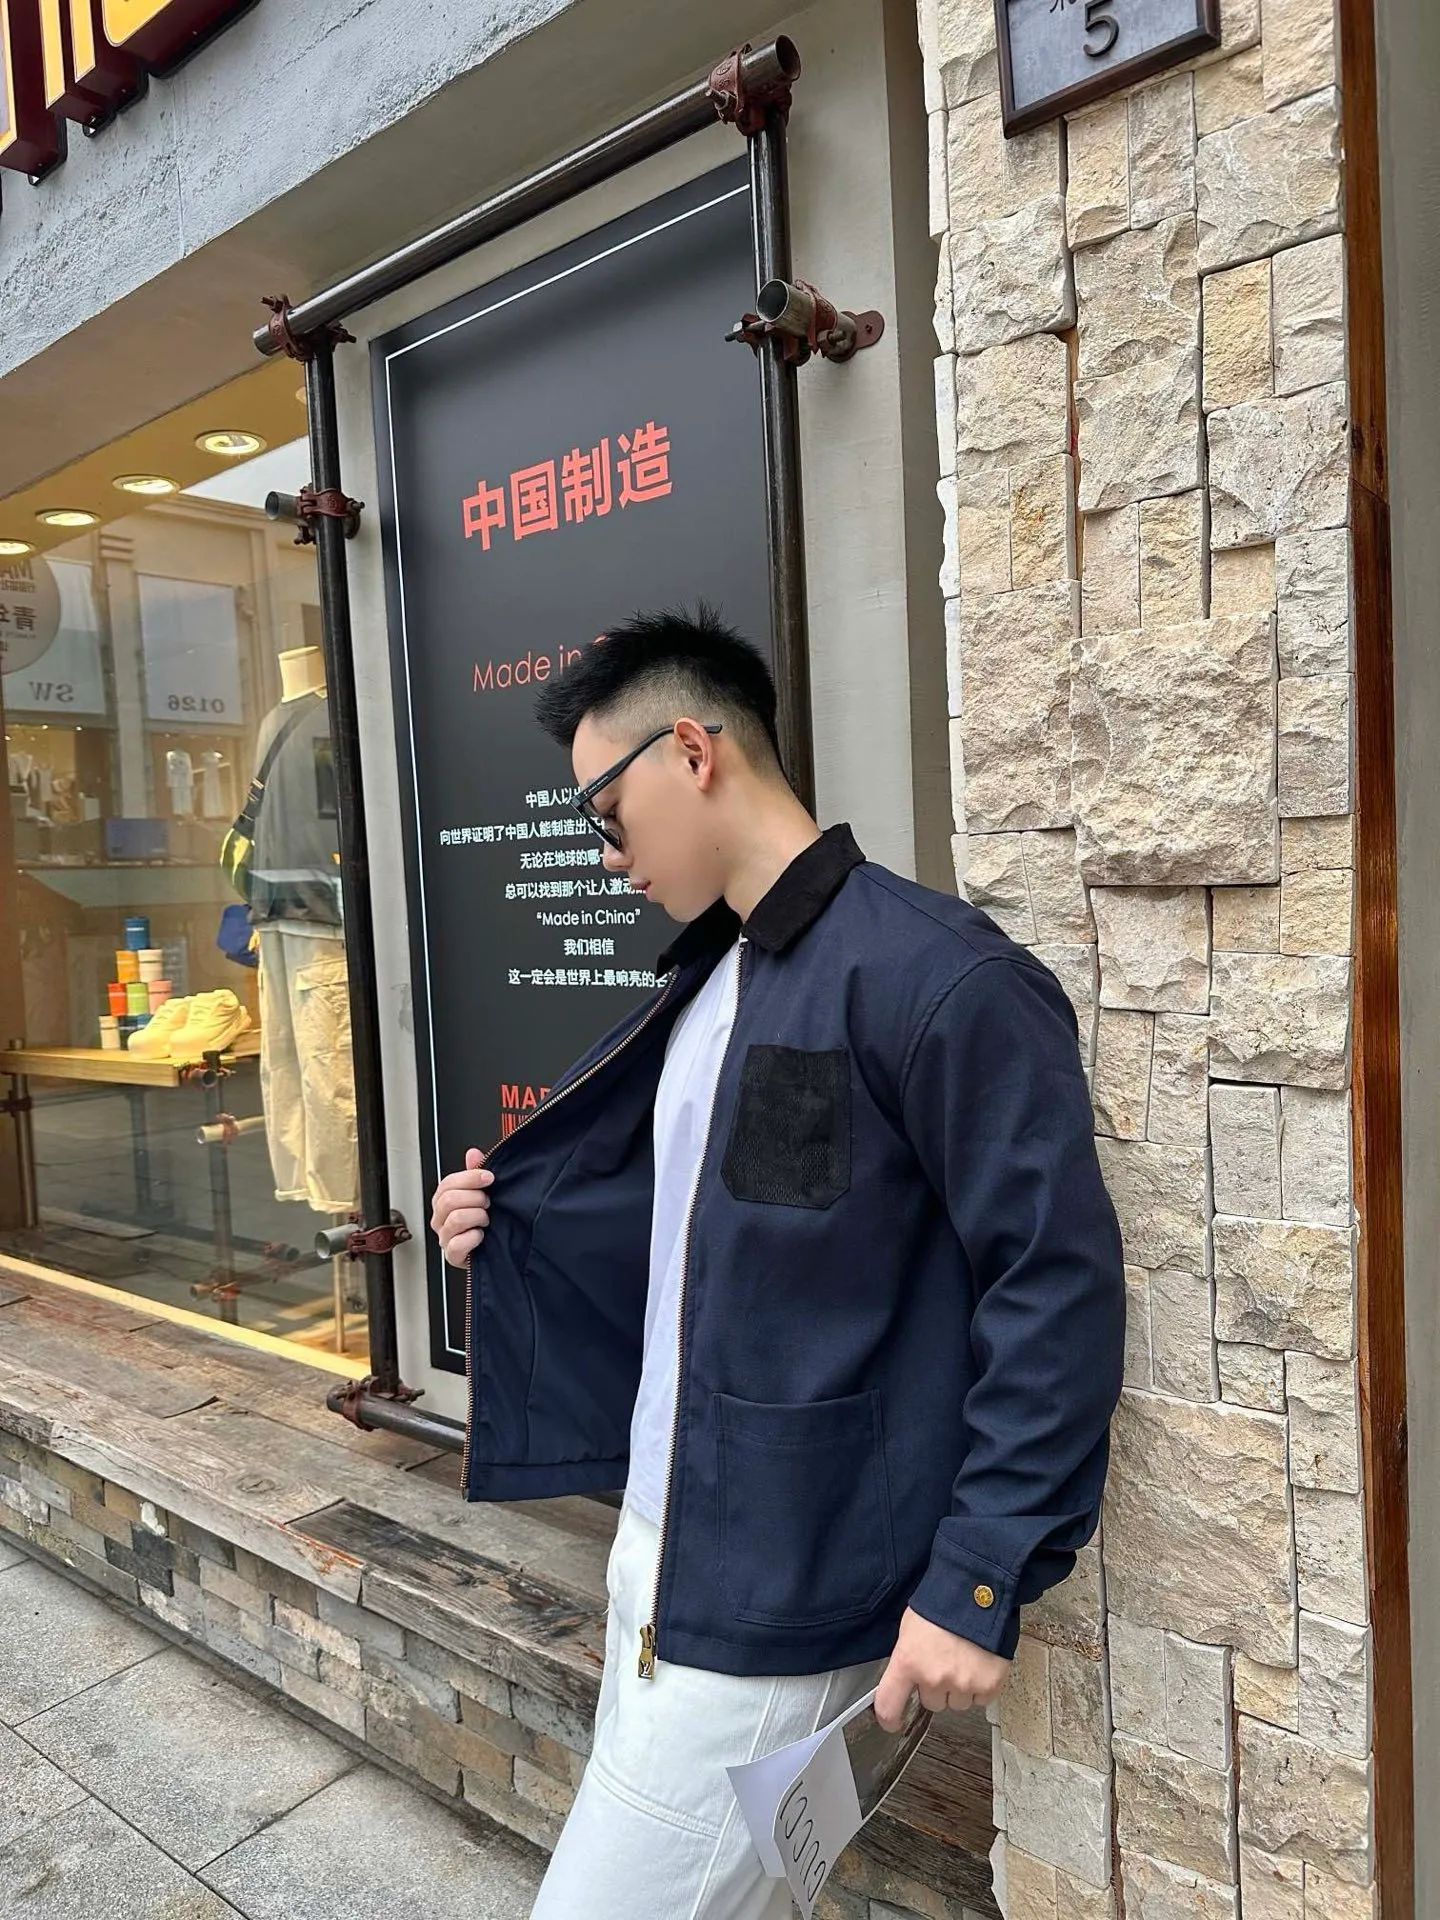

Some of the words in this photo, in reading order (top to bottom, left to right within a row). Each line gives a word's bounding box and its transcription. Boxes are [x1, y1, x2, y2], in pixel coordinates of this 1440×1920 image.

[1083, 0, 1119, 57] 5
[463, 421, 672, 551] 中国制造
[473, 651, 551, 692] Made
[559, 644, 582, 676] in
[440, 818, 605, 846] 向世界证明了中国人能制造出
[520, 849, 604, 869] 无论在地球的哪
[505, 877, 647, 900] 总可以找到那个让人激动
[581, 910, 593, 925] in
[563, 938, 615, 956] 我们相信
[779, 1780, 827, 1903] GUCCI
